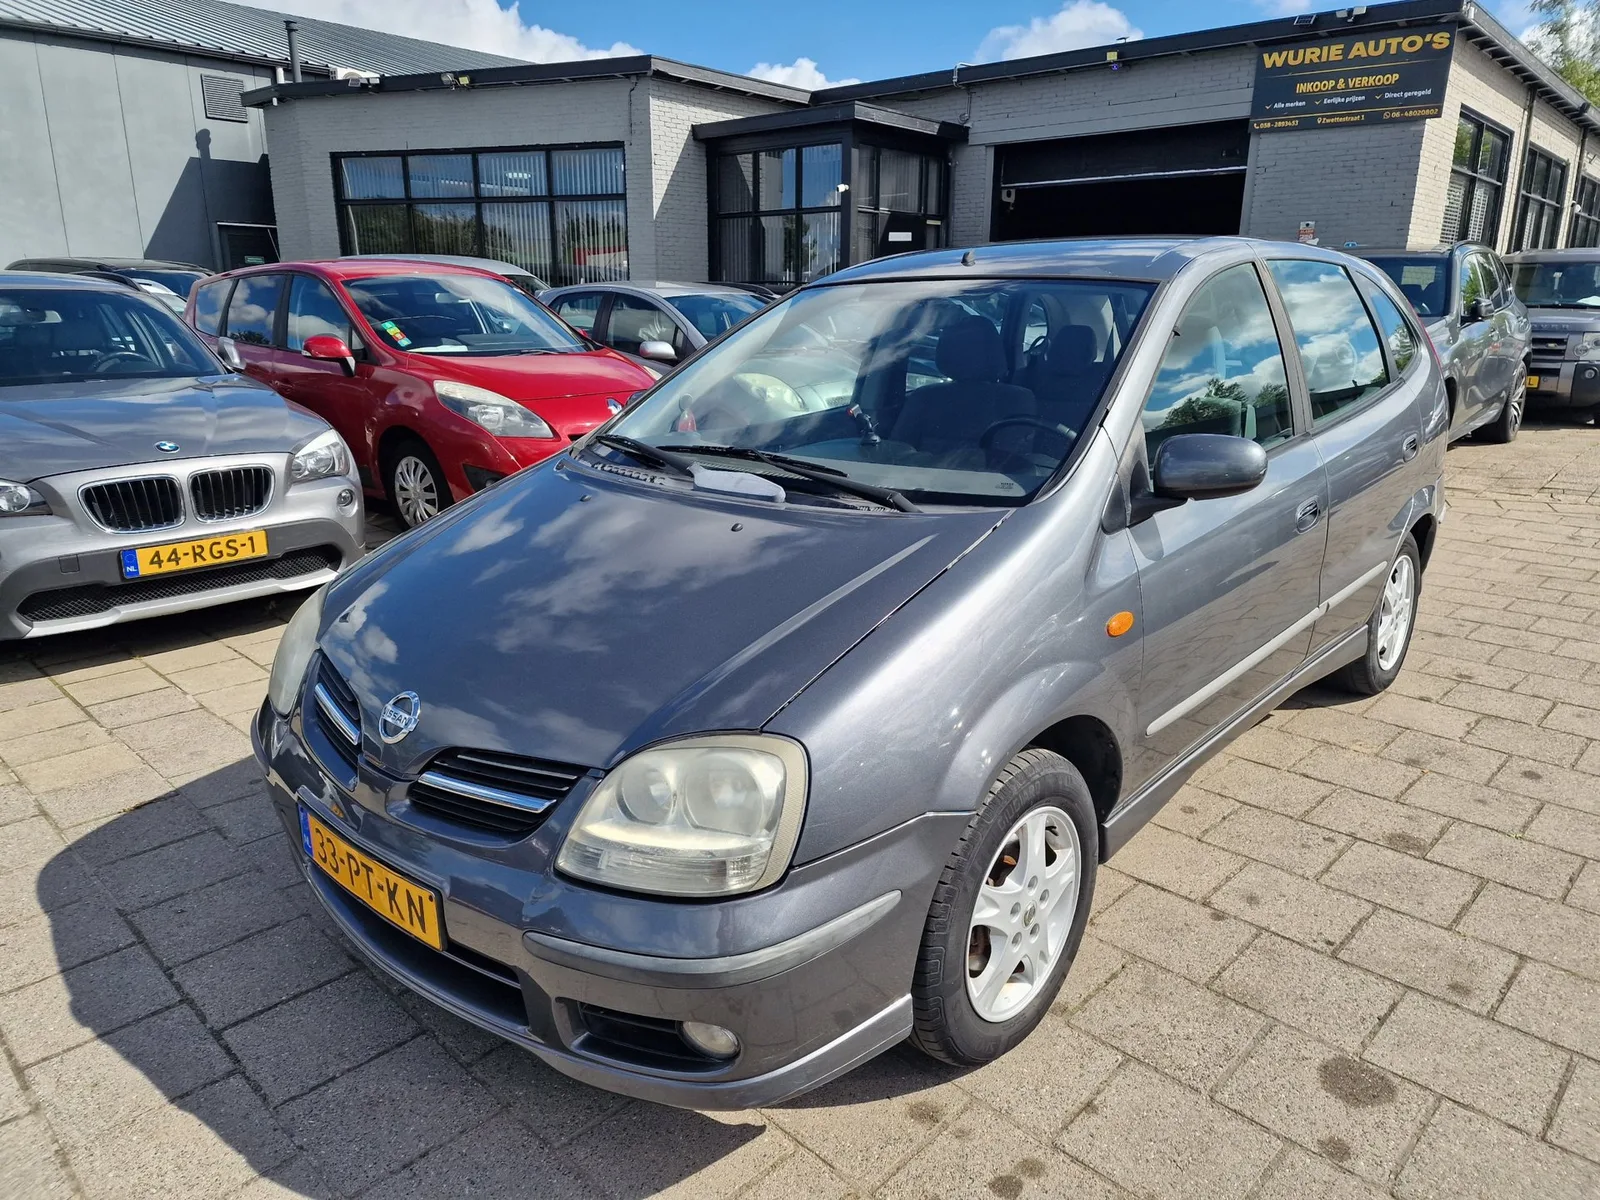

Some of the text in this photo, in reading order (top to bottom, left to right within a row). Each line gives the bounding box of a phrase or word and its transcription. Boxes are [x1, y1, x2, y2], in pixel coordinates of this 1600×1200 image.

[1262, 31, 1451, 69] WURIE AUTO'S
[1295, 73, 1400, 94] INKOOP & VERKOOP
[1384, 88, 1432, 99] Direct geregeld
[1323, 95, 1366, 105] Eerlijke prijzen
[1321, 115, 1361, 124] Zwettestraat
[148, 535, 256, 570] 44-RGS-1
[126, 565, 138, 573] NL
[382, 705, 410, 727] NISSAN
[314, 827, 428, 935] 33-PT-KN
